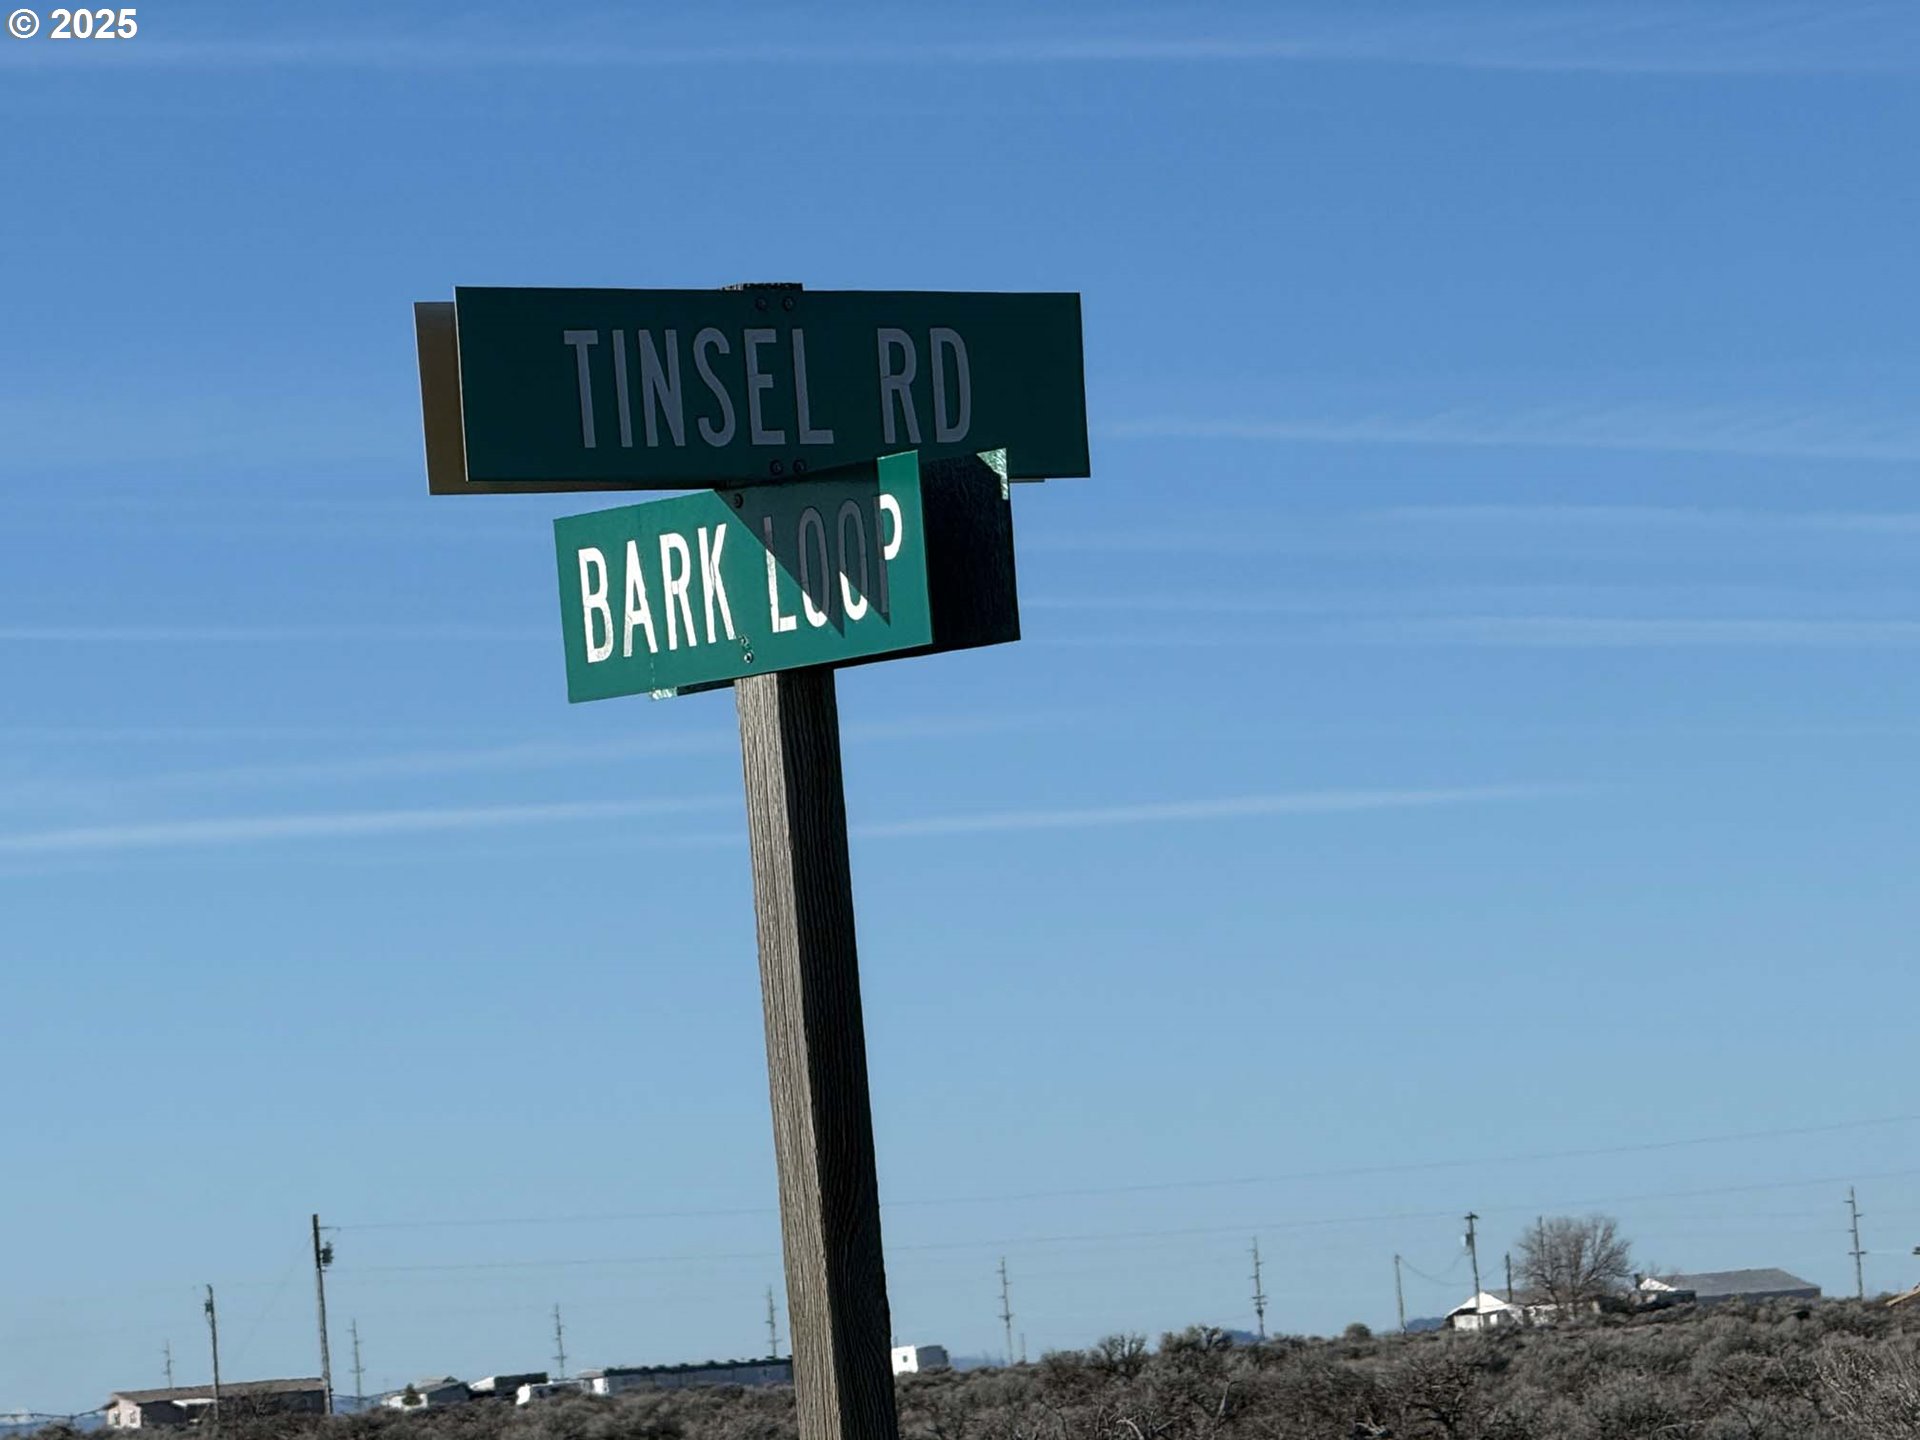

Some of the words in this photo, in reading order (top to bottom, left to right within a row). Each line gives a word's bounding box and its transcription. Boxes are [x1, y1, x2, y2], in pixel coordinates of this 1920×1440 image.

[563, 327, 834, 448] TINSEL
[877, 327, 972, 444] RD
[577, 523, 736, 663] BARK
[763, 493, 903, 632] LOOP
